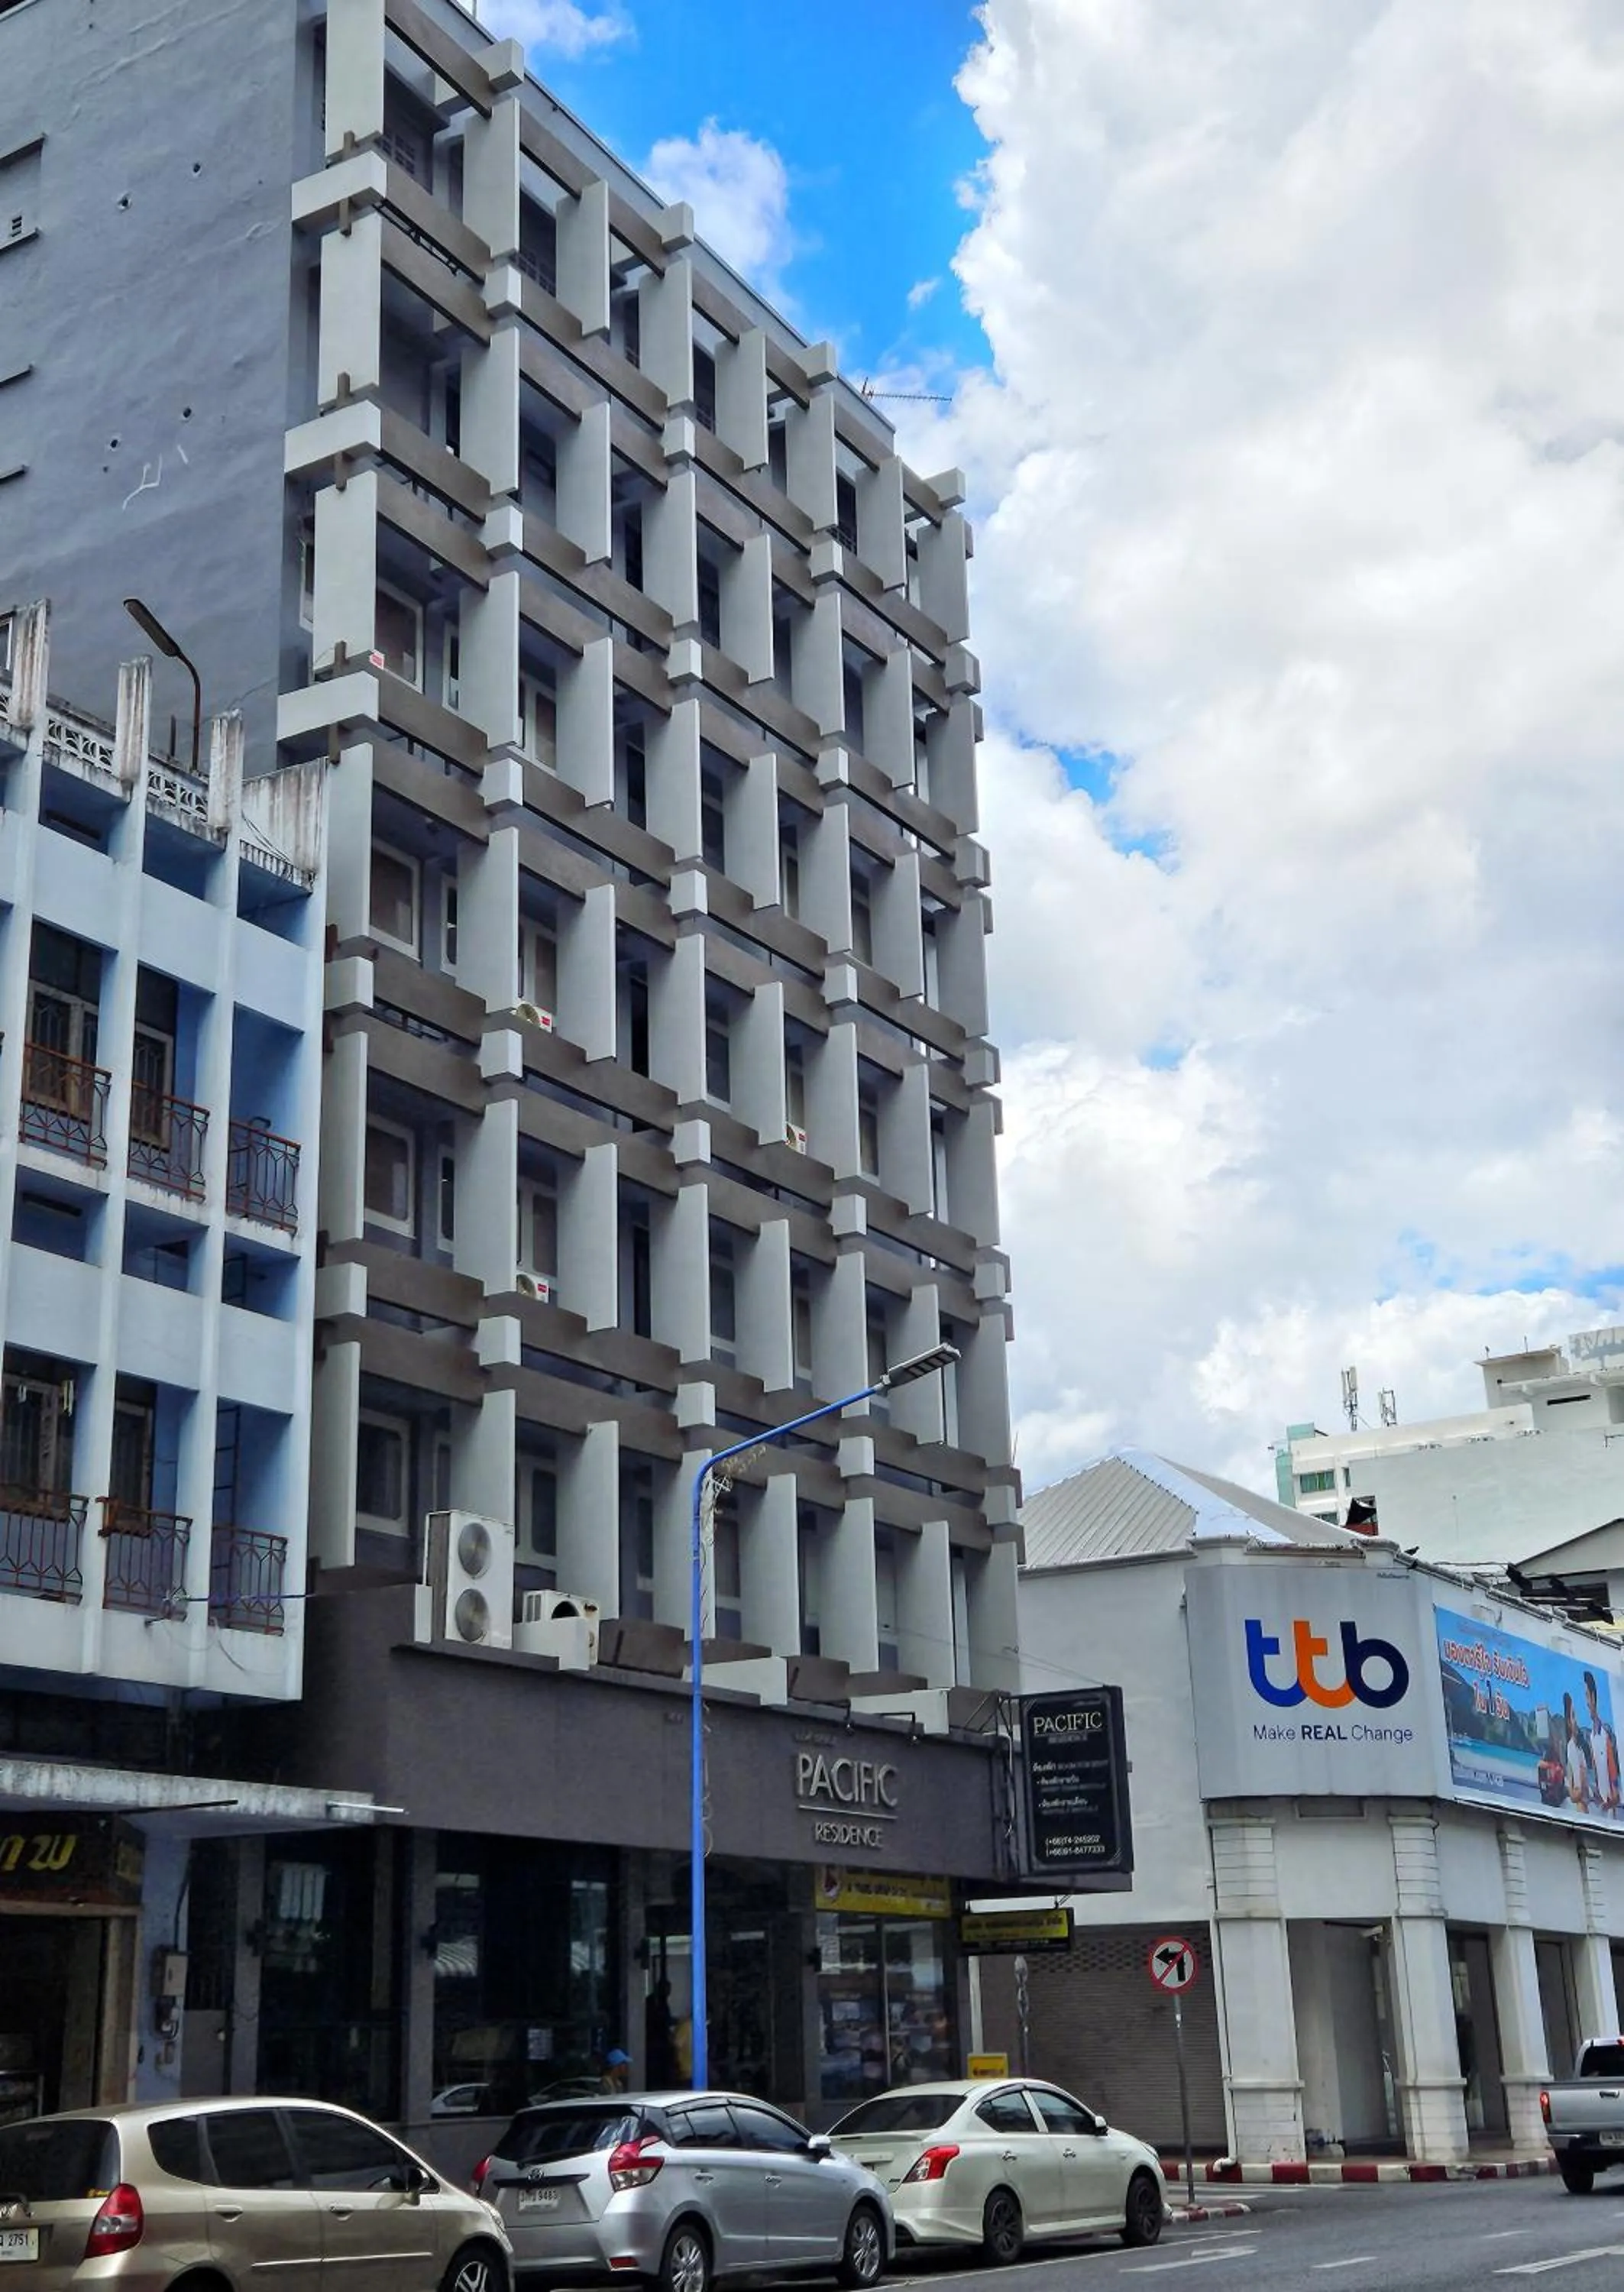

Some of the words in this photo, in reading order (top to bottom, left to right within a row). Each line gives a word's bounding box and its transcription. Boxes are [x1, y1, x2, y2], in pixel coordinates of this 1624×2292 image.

[1244, 1619, 1409, 1709] ttb
[1034, 1711, 1103, 1734] PACIFIC
[1254, 1725, 1296, 1741] Make
[1301, 1725, 1347, 1740] REAL
[1351, 1724, 1413, 1744] Change
[798, 1753, 898, 1807] PACIFIC
[815, 1822, 883, 1847] RESIDENCE
[8, 2234, 28, 2247] 2751
